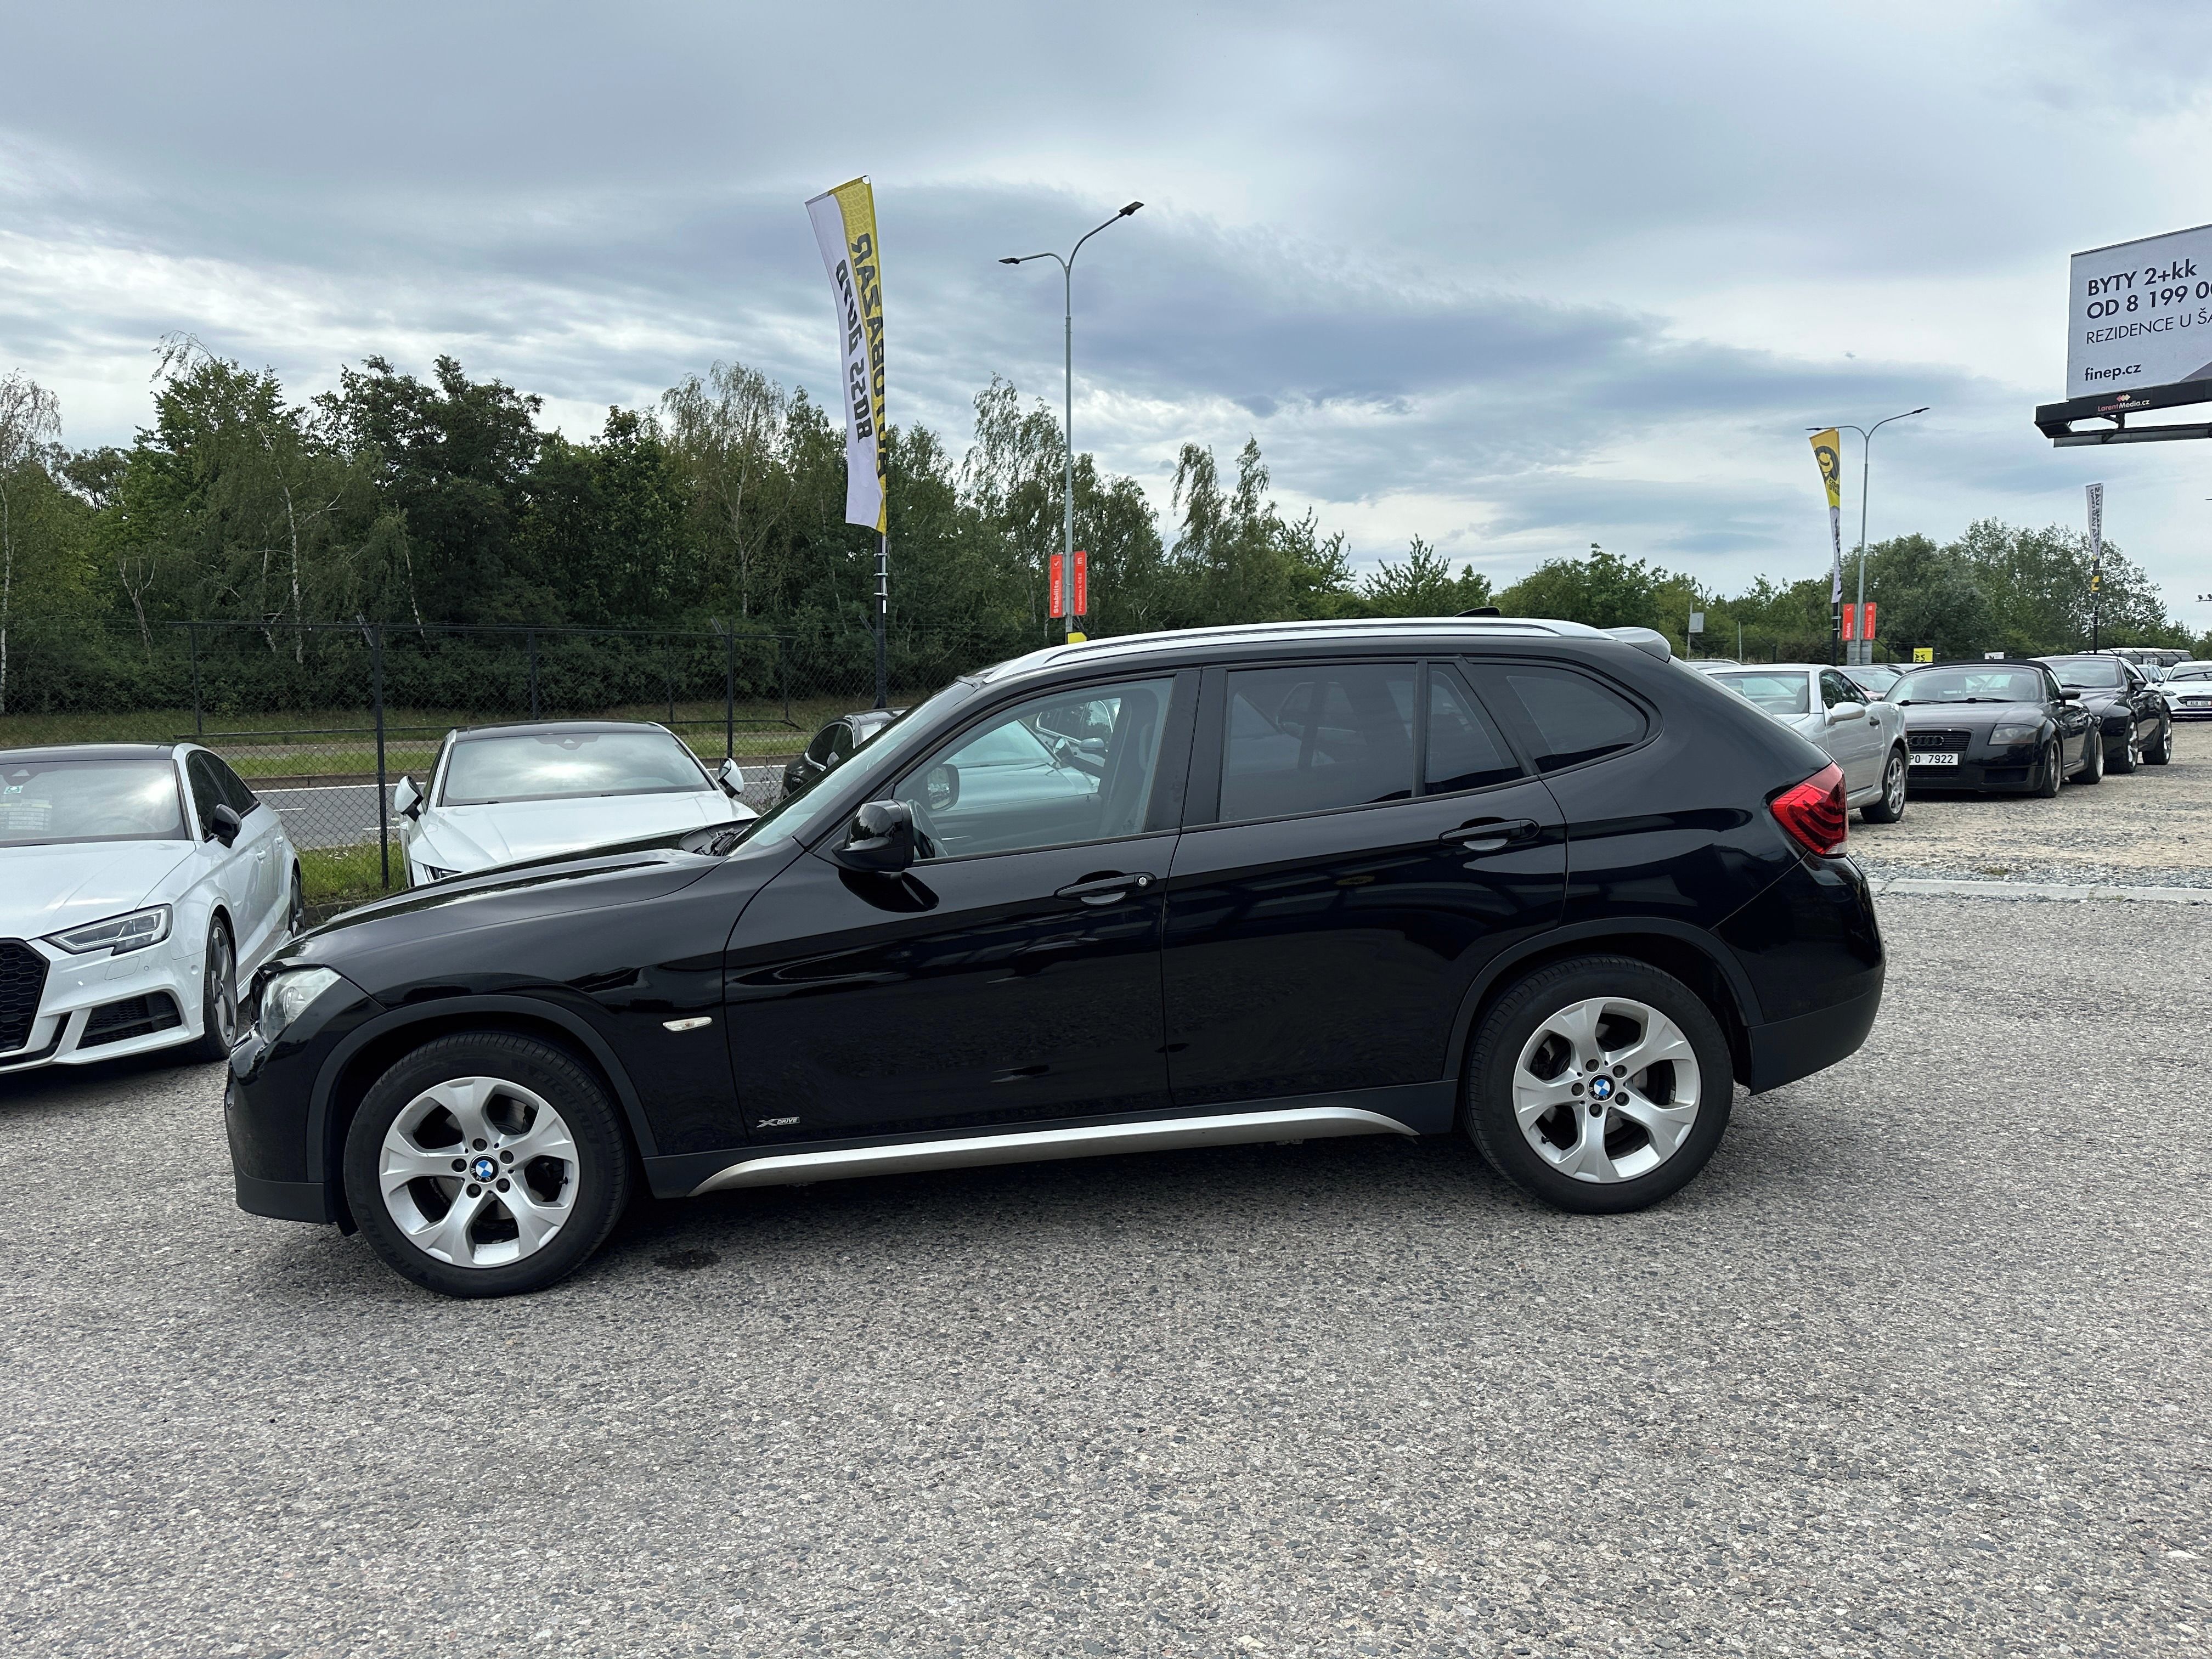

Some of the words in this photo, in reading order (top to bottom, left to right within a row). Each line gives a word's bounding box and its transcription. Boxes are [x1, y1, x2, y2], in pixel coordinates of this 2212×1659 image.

[2088, 270, 2138, 296] BYTY
[2144, 258, 2197, 285] 2+kk
[2087, 299, 2119, 319] OD
[2126, 295, 2138, 312] 8
[2149, 285, 2188, 308] 199
[2196, 281, 2212, 299] 0
[2086, 317, 2174, 345] REZIDENCE
[2180, 313, 2192, 328] U
[2085, 364, 2142, 381] finep.cz
[2098, 399, 2151, 412] LarentMedia.cz
[1928, 754, 1953, 764] 7922
[470, 1167, 491, 1182] BMW
